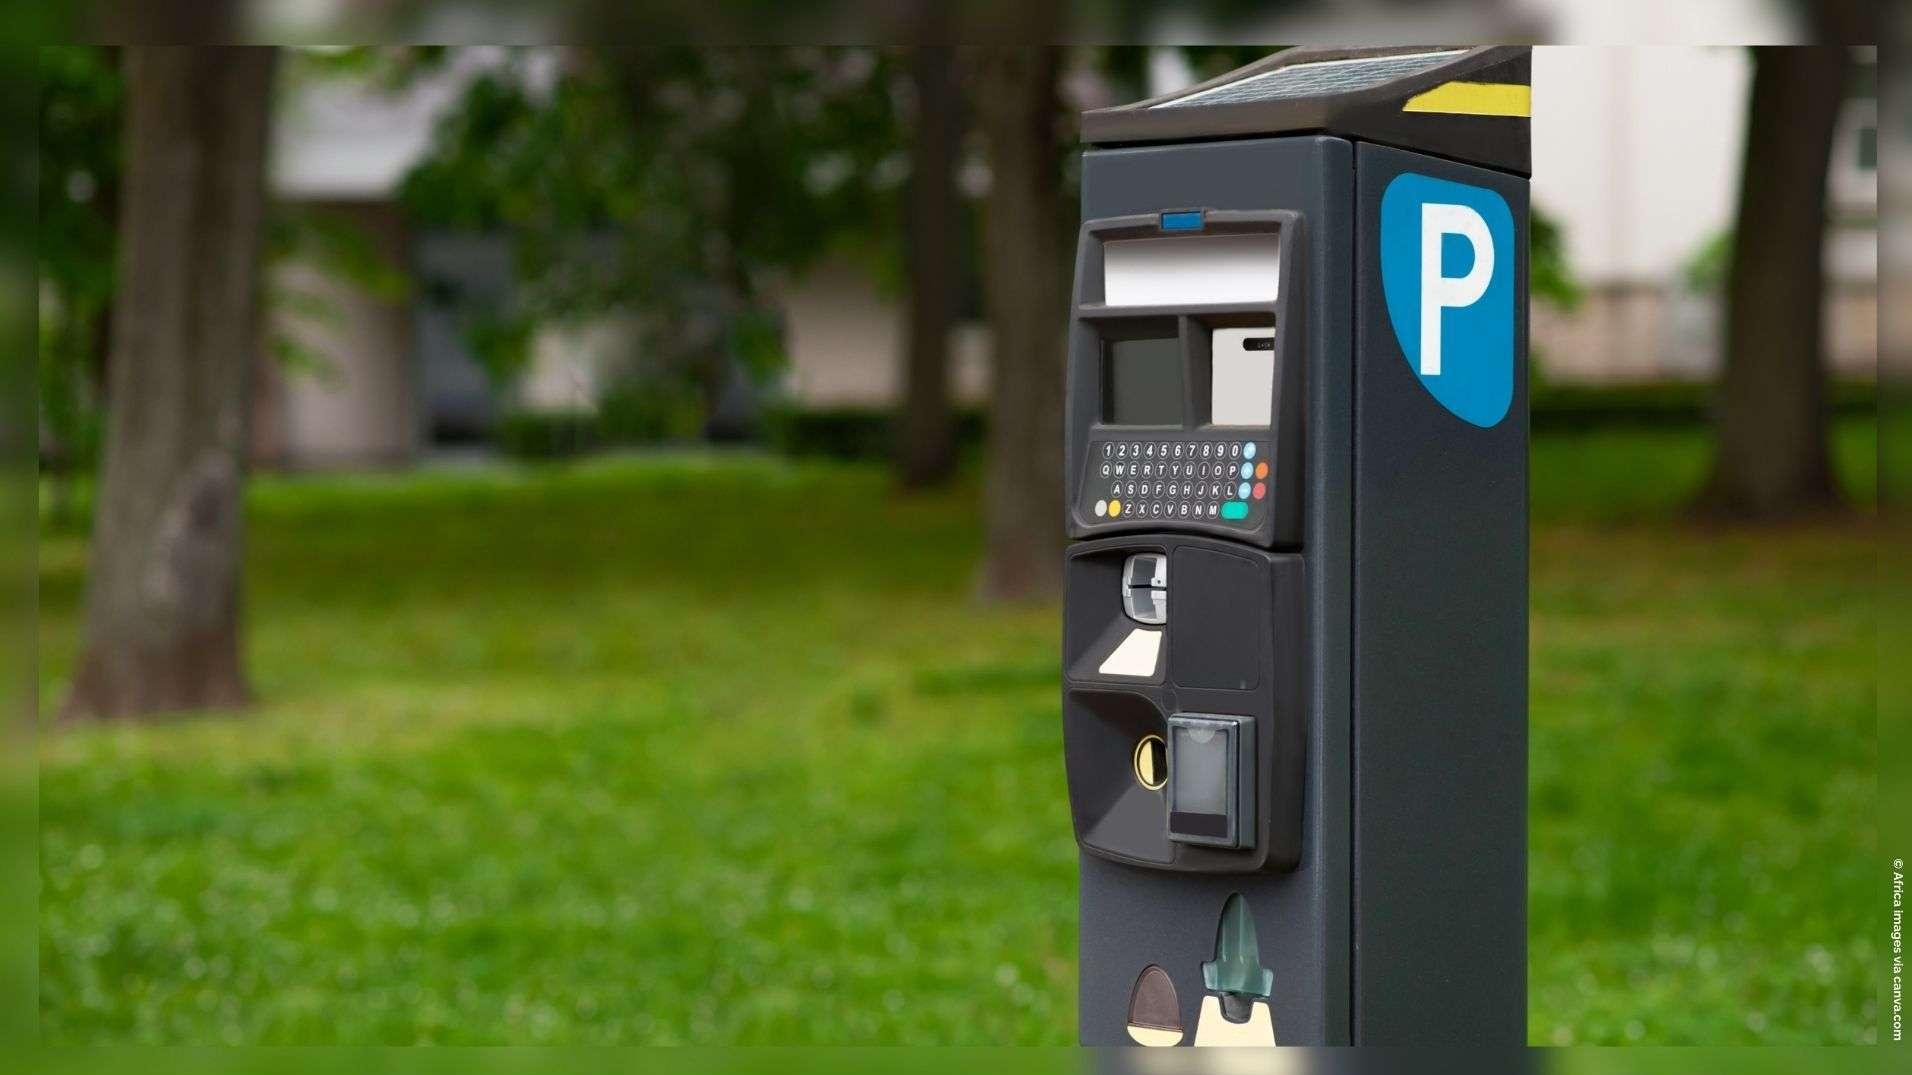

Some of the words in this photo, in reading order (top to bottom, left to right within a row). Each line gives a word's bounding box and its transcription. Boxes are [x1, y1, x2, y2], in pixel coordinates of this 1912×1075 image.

[1420, 202, 1495, 375] P
[1106, 444, 1111, 457] 1
[1118, 444, 1126, 457] 2
[1132, 444, 1140, 457] 3
[1146, 444, 1153, 457] 4
[1160, 444, 1168, 457] 5
[1174, 444, 1182, 457] 6
[1189, 444, 1196, 457] 7
[1202, 444, 1210, 457] 8
[1217, 444, 1224, 457] 9
[1231, 444, 1239, 457] 0
[1102, 464, 1110, 476] Q
[1115, 464, 1125, 475] W
[1130, 464, 1137, 475] E
[1143, 465, 1151, 475] R
[1158, 464, 1165, 476] T
[1172, 465, 1179, 475] Y
[1185, 464, 1193, 476] U
[1201, 465, 1206, 476] I
[1214, 465, 1222, 476] O
[1229, 465, 1236, 476] P
[1113, 484, 1121, 494] A
[1127, 484, 1135, 495] S
[1141, 484, 1149, 495] D
[1155, 484, 1162, 495] F
[1168, 484, 1177, 495] G
[1183, 485, 1191, 495] H
[1197, 485, 1205, 496] J
[1212, 485, 1220, 496] K
[1227, 485, 1233, 496] L
[1124, 503, 1132, 514] Z
[1138, 504, 1146, 514] X
[1152, 504, 1160, 515] C
[1167, 504, 1174, 515] V
[1180, 504, 1188, 515] B
[1194, 504, 1203, 515] N
[1208, 505, 1218, 515] M
